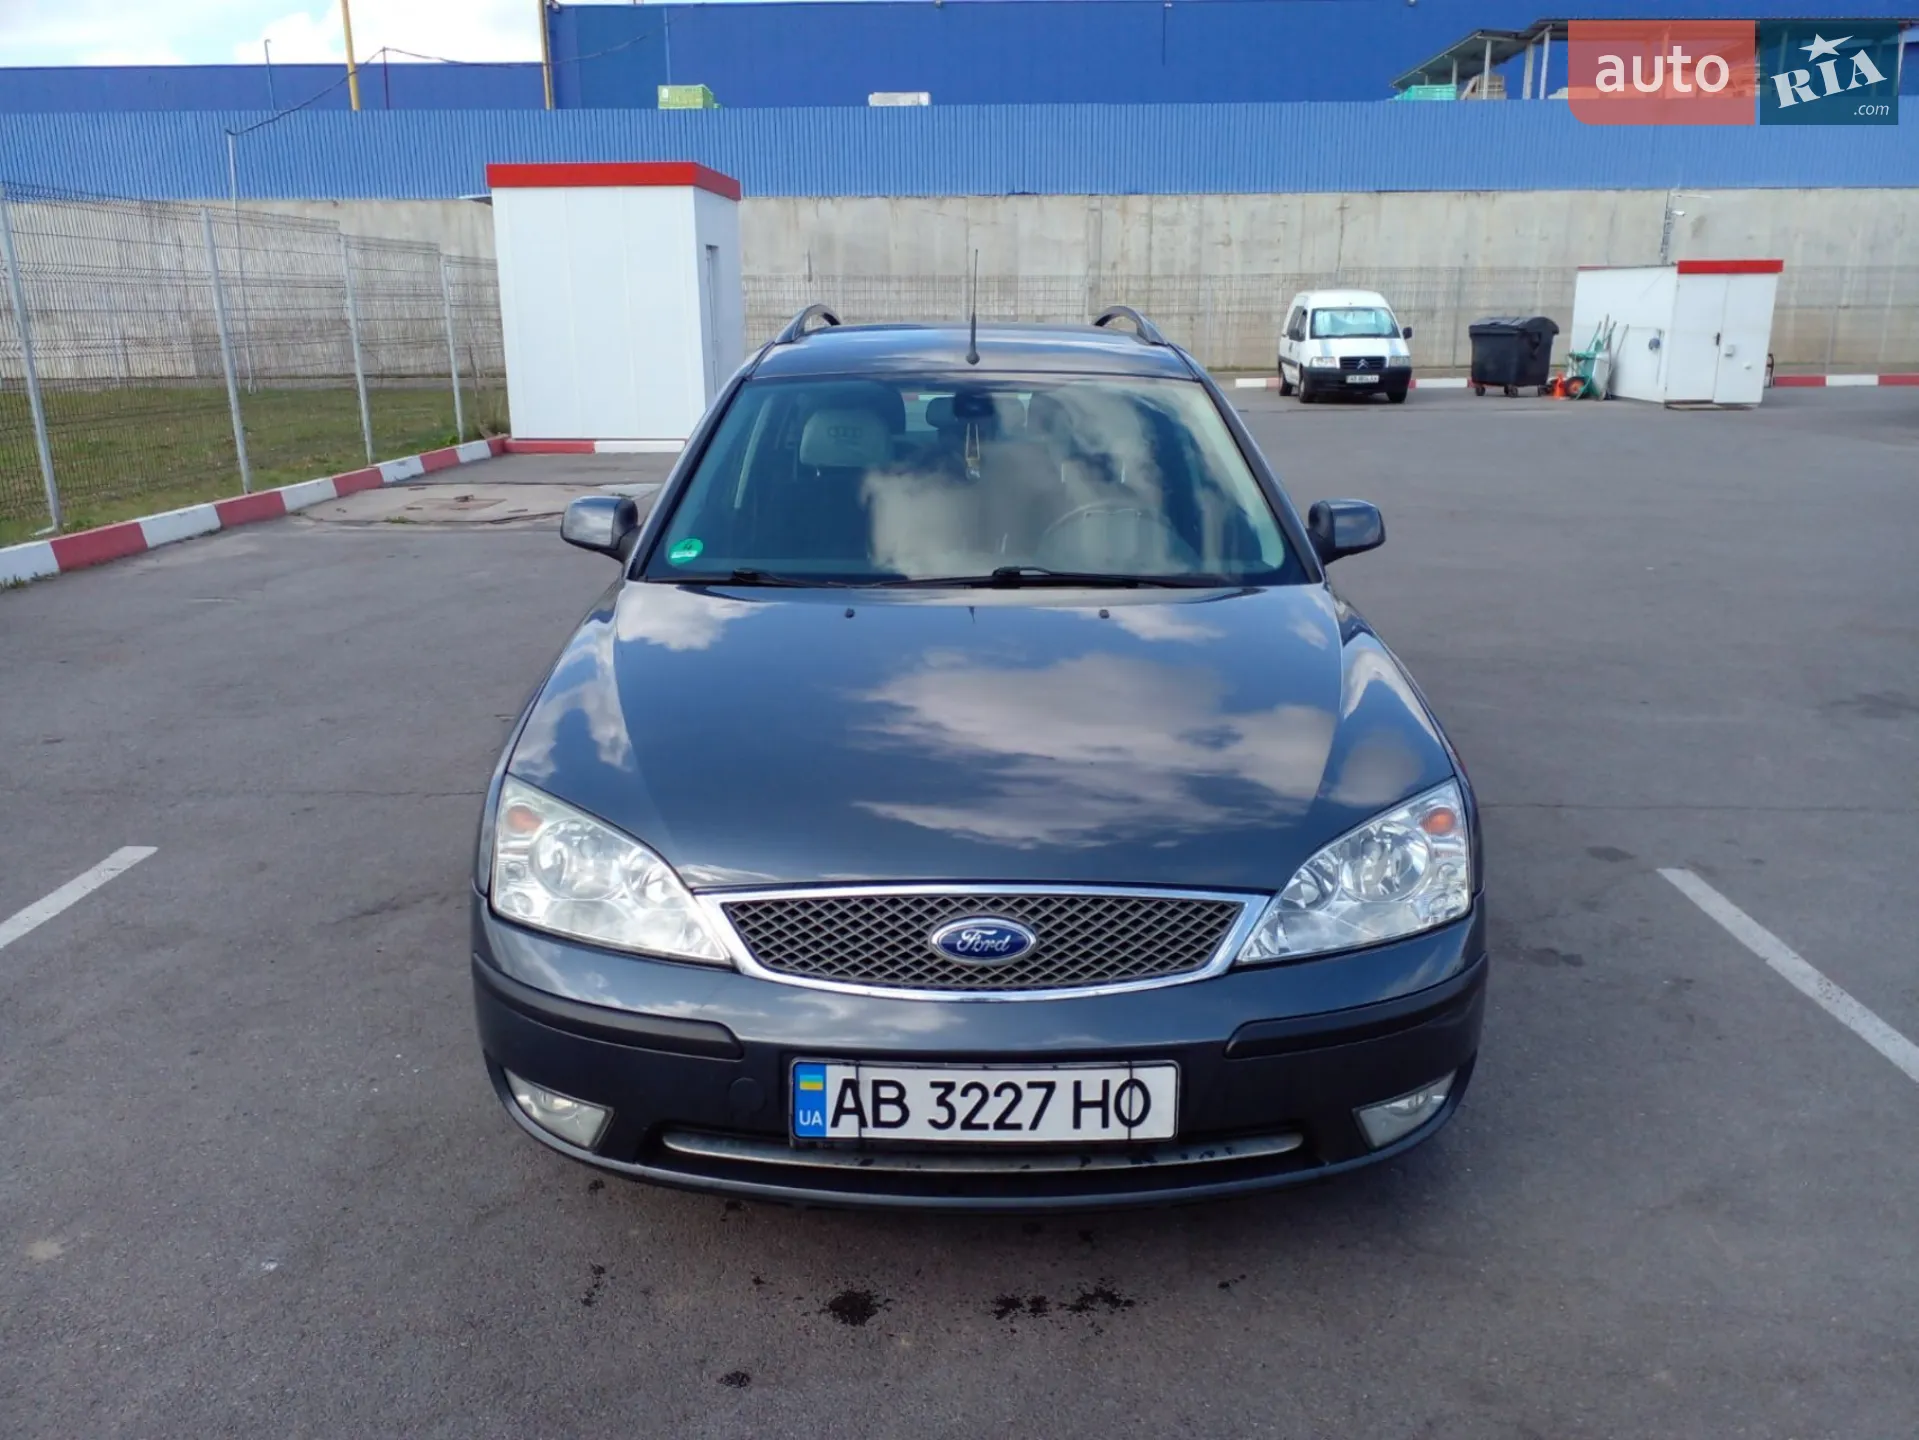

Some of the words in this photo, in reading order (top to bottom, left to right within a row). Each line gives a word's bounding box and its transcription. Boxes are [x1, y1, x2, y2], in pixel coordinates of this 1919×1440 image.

[956, 928, 1012, 953] Ford
[830, 1077, 911, 1129] AB
[927, 1080, 1057, 1131] 3227
[1072, 1078, 1152, 1129] HO
[799, 1109, 824, 1126] UA
